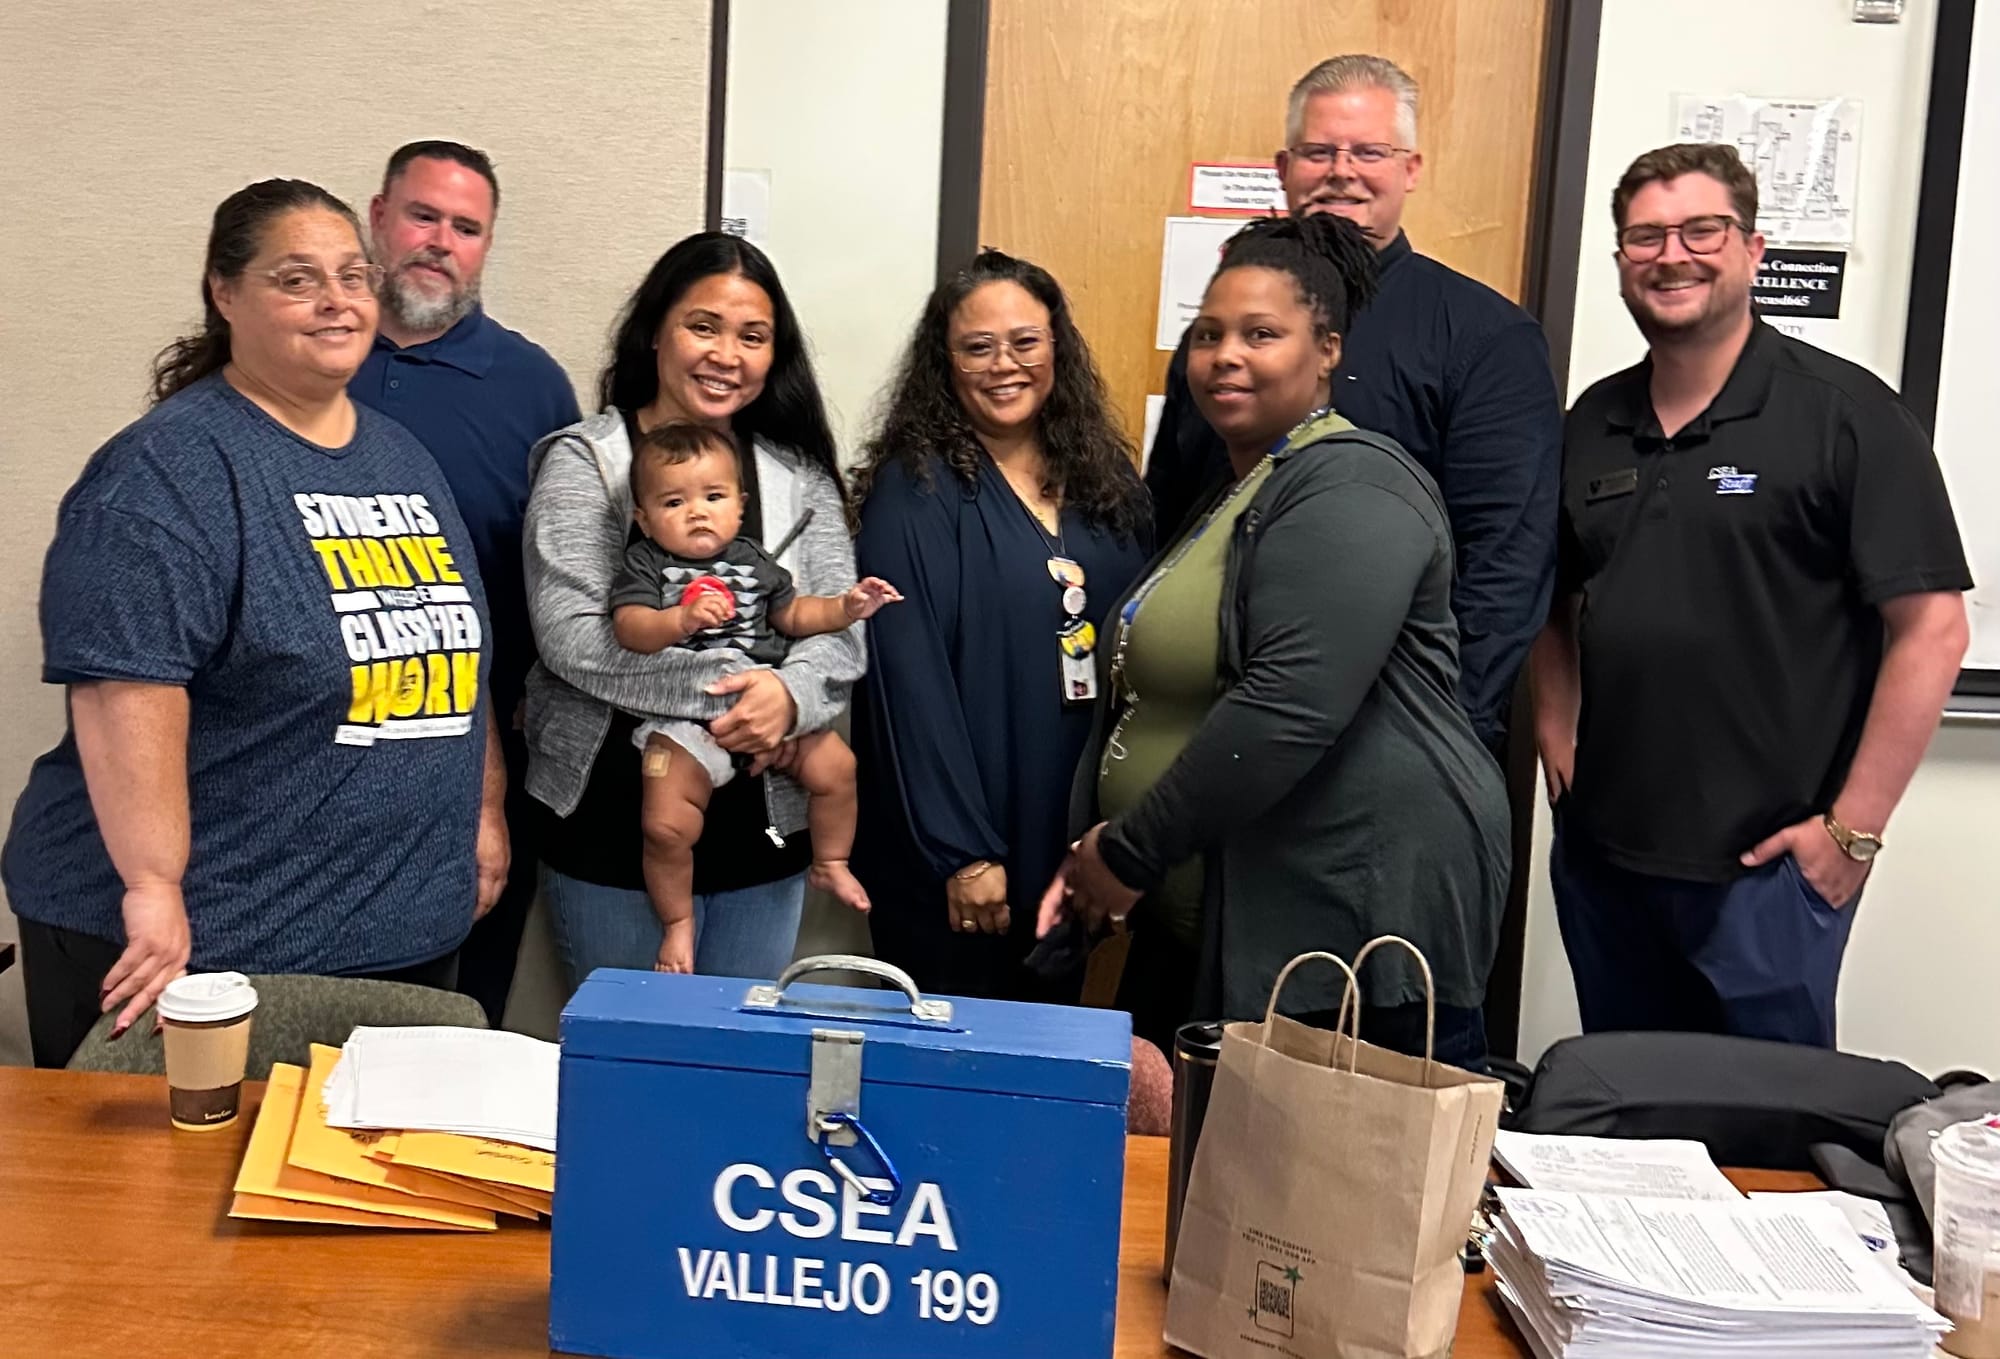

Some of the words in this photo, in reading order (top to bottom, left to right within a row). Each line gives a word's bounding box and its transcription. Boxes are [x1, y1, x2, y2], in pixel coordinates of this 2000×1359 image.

[1770, 260, 1839, 274] Connection
[293, 493, 440, 538] STUDENTS
[311, 536, 463, 590] THRIVE
[347, 652, 480, 724] WORK
[712, 1163, 958, 1251] CSEA
[677, 1247, 891, 1315] VALLEJO
[910, 1268, 999, 1326] 199
